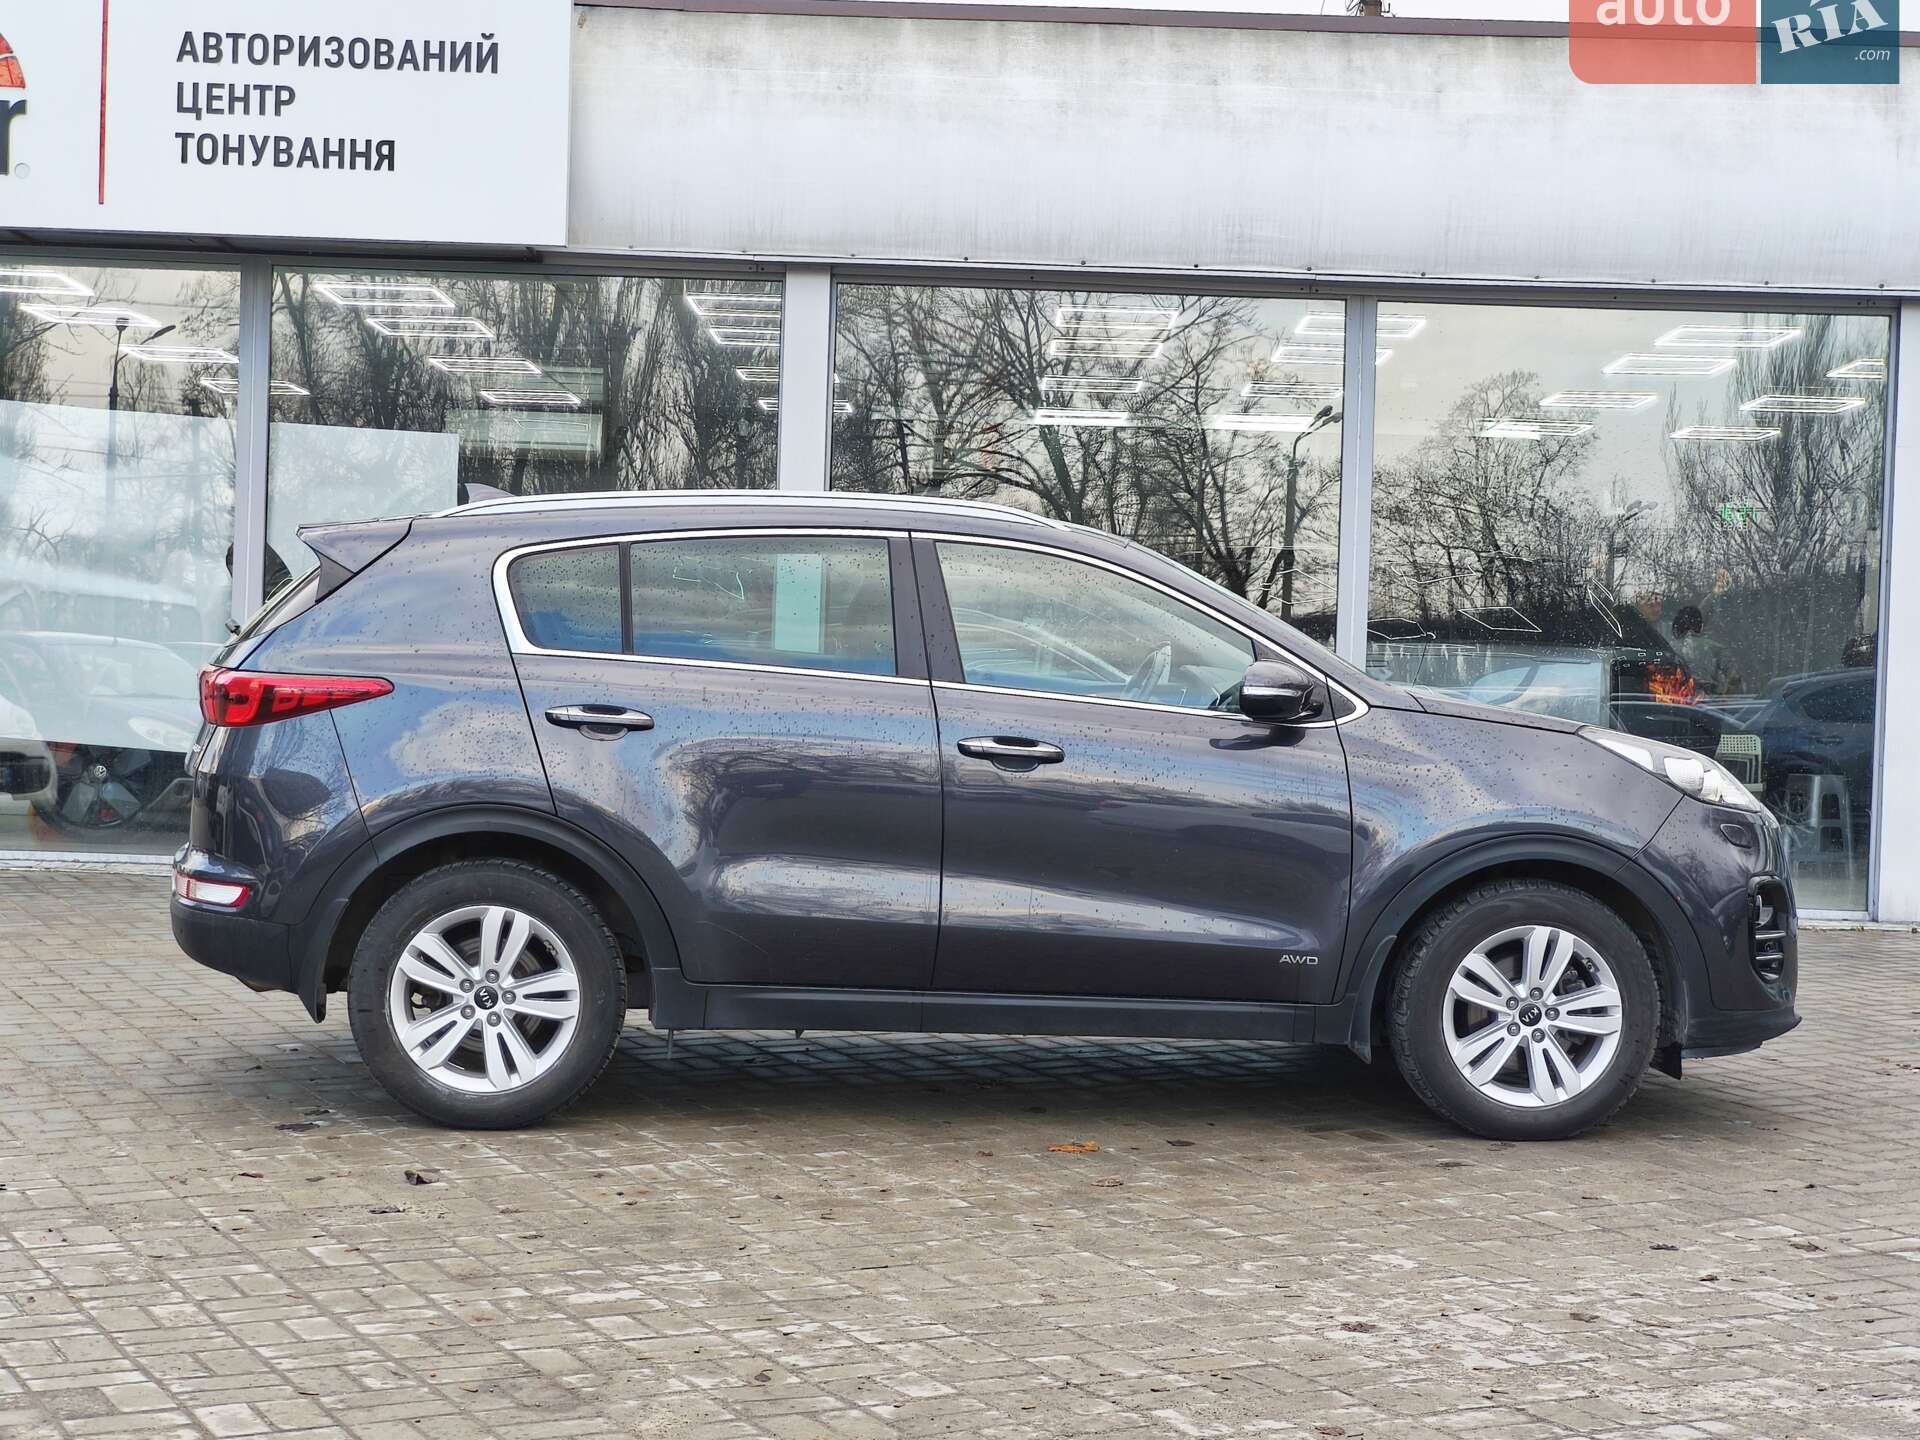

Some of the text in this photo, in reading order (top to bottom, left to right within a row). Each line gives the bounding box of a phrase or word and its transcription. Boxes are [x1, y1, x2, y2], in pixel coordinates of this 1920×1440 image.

[176, 31, 499, 74] АВТОРИЗОВАНИЙ
[176, 81, 296, 121] ЦЕНТР
[174, 132, 396, 172] ТОНУВАННЯ
[1279, 954, 1319, 965] AWD
